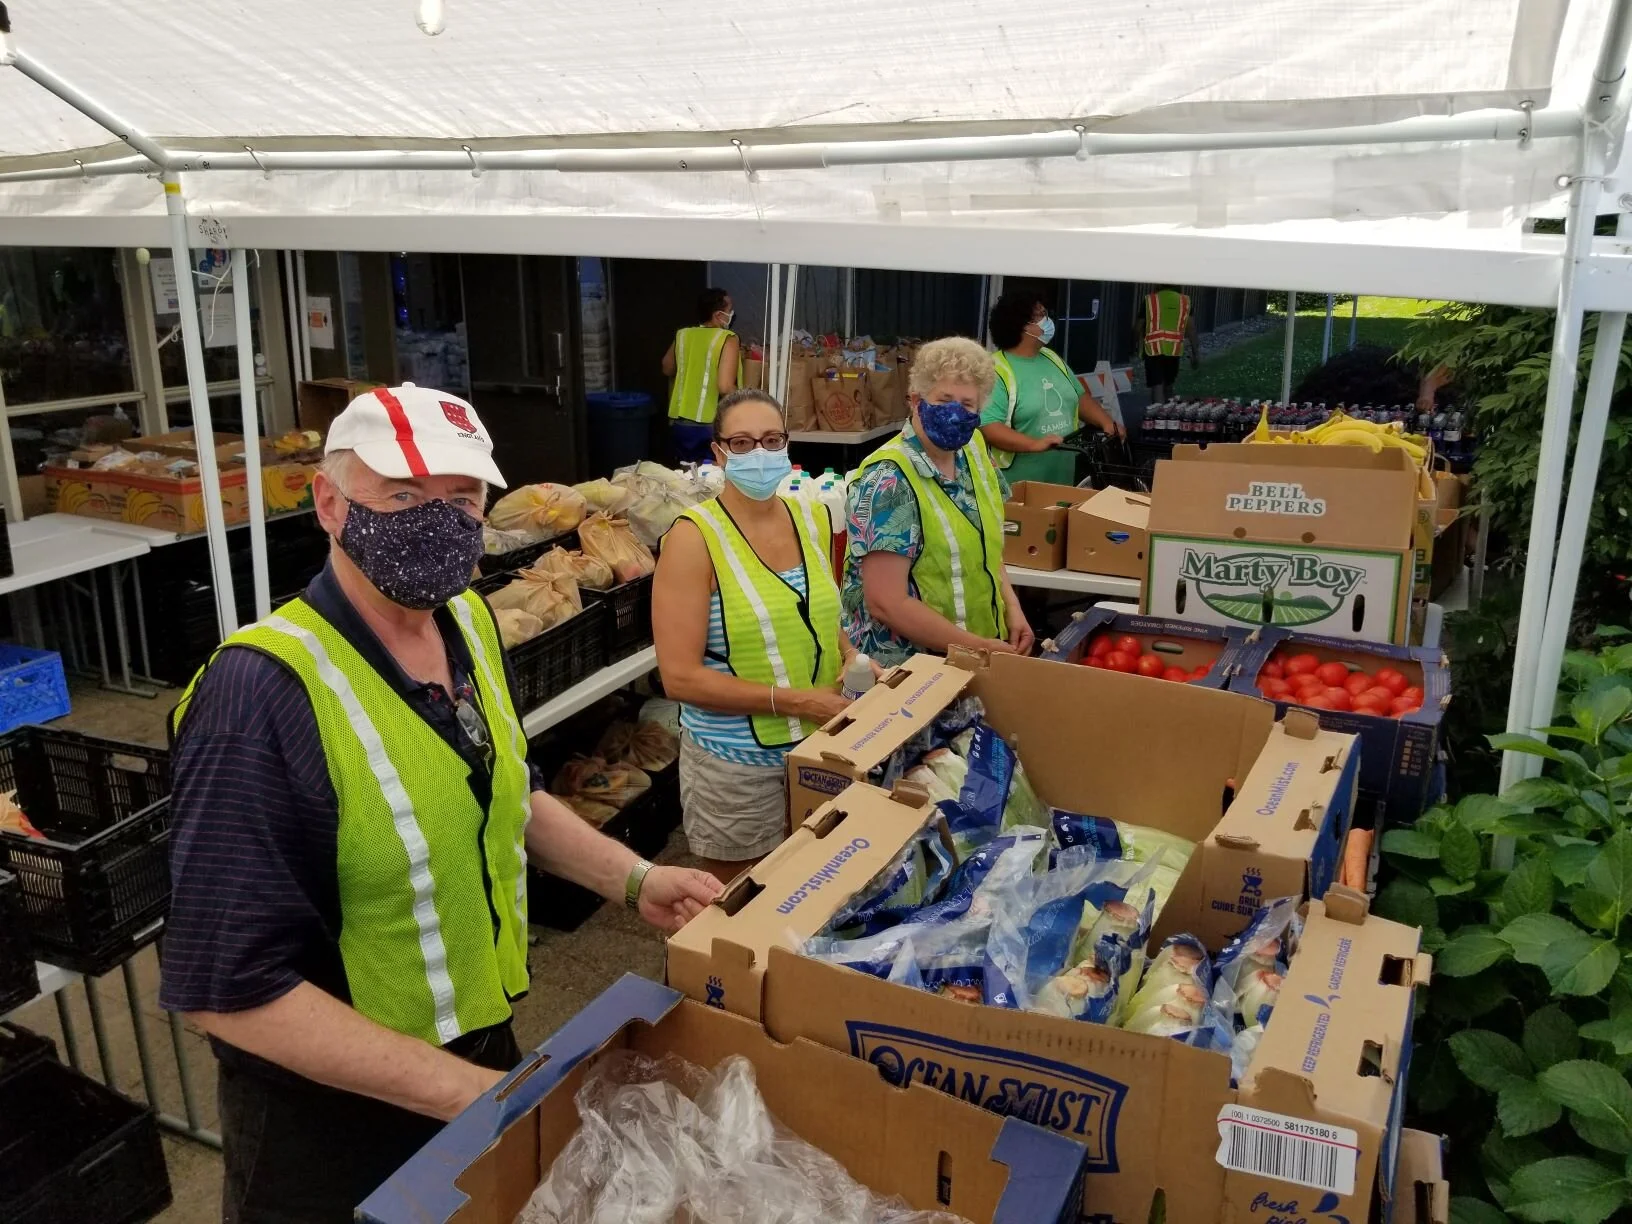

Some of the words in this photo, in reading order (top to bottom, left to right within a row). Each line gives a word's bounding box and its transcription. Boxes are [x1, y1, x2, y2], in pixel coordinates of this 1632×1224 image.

[1252, 484, 1303, 499] BELL
[1229, 497, 1323, 514] PEPPERS
[1180, 548, 1290, 593] Marty
[1289, 554, 1367, 596] Boy
[1255, 762, 1300, 816] OceanMist.com
[776, 837, 870, 914] OceanMist.com
[1239, 895, 1260, 908] GRILL
[1307, 1012, 1331, 1057] REFRIGERATED
[1302, 1055, 1317, 1073] KEEP
[1284, 1121, 1330, 1139] 581175180
[1331, 1131, 1338, 1140] 6
[1250, 1192, 1298, 1215] fresh
